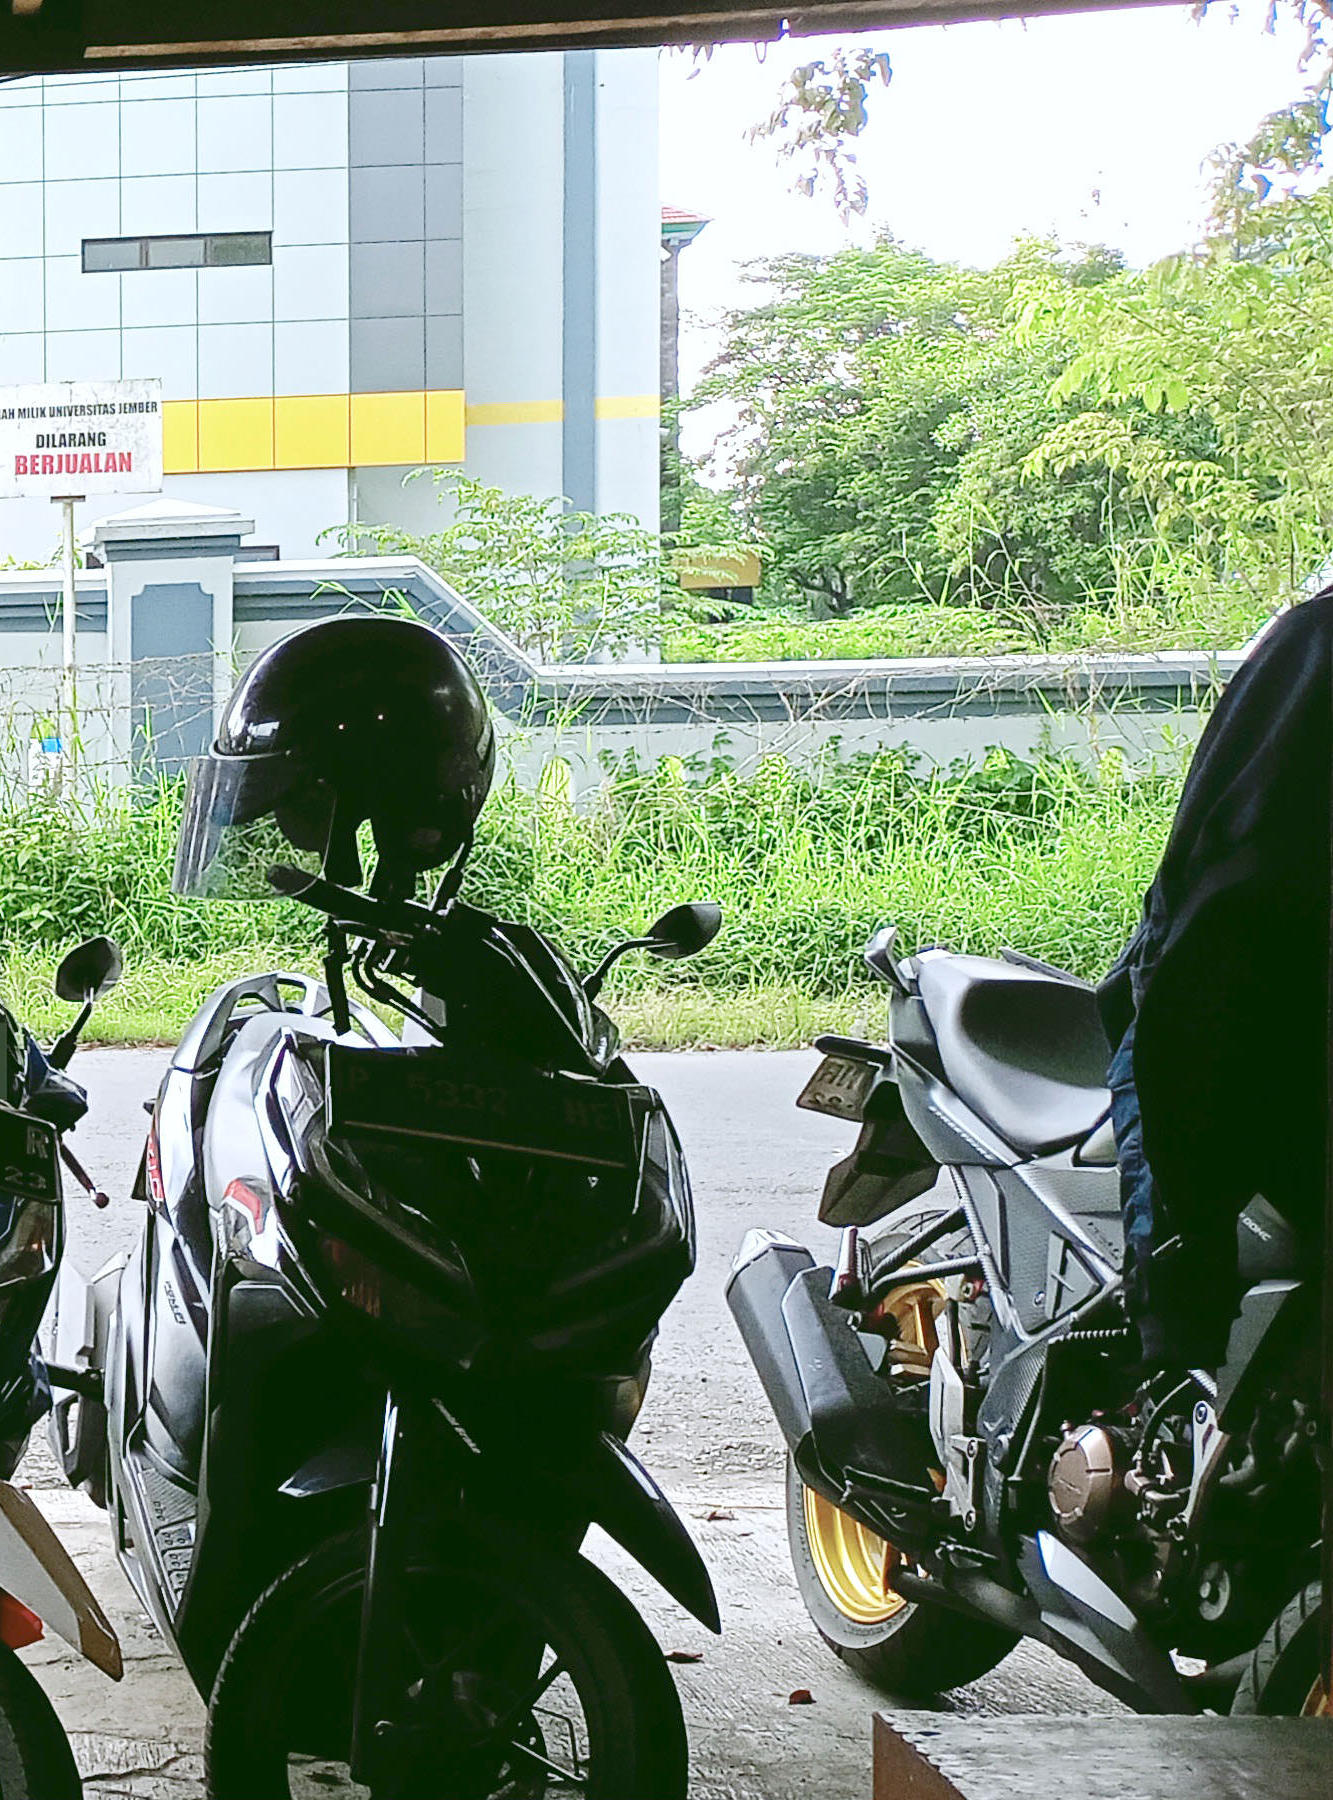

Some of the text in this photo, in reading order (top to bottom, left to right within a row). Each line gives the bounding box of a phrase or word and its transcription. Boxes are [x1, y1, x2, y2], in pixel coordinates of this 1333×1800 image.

[18, 406, 46, 419] MILIK
[49, 403, 116, 418] UNIVERSITAS
[118, 401, 158, 415] JEMBER
[36, 432, 107, 449] DILARANG
[14, 451, 132, 476] BERJUALAN
